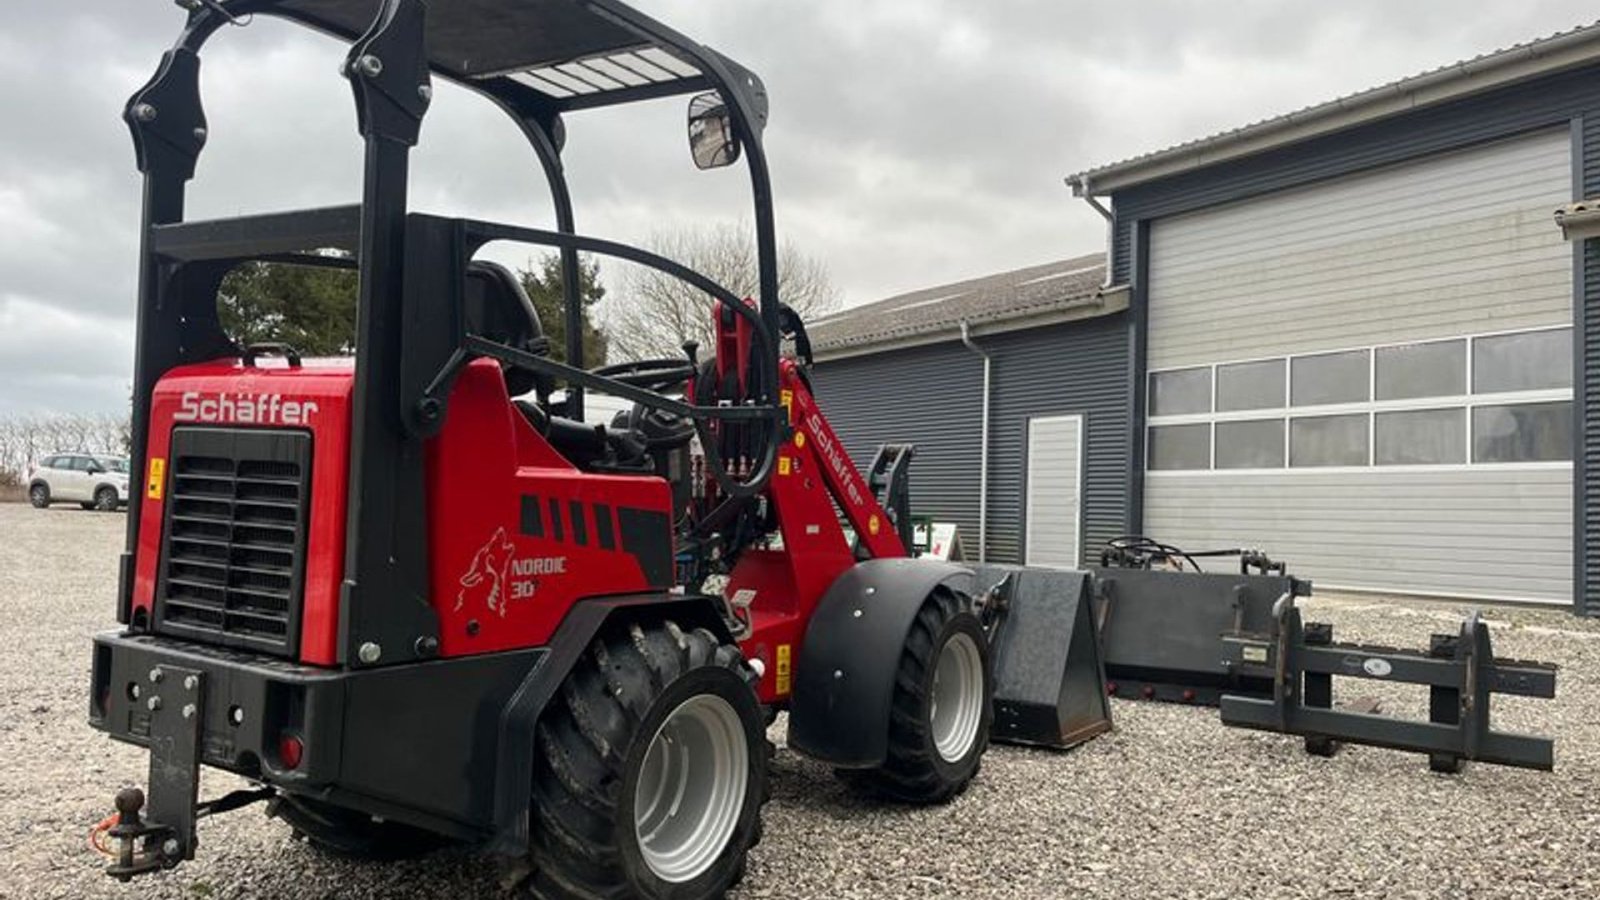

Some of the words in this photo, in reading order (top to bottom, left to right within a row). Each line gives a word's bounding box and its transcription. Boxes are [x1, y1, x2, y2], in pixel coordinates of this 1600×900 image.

[174, 392, 319, 425] Schäffer
[807, 414, 864, 506] Schäffer
[511, 557, 567, 576] NORDIC
